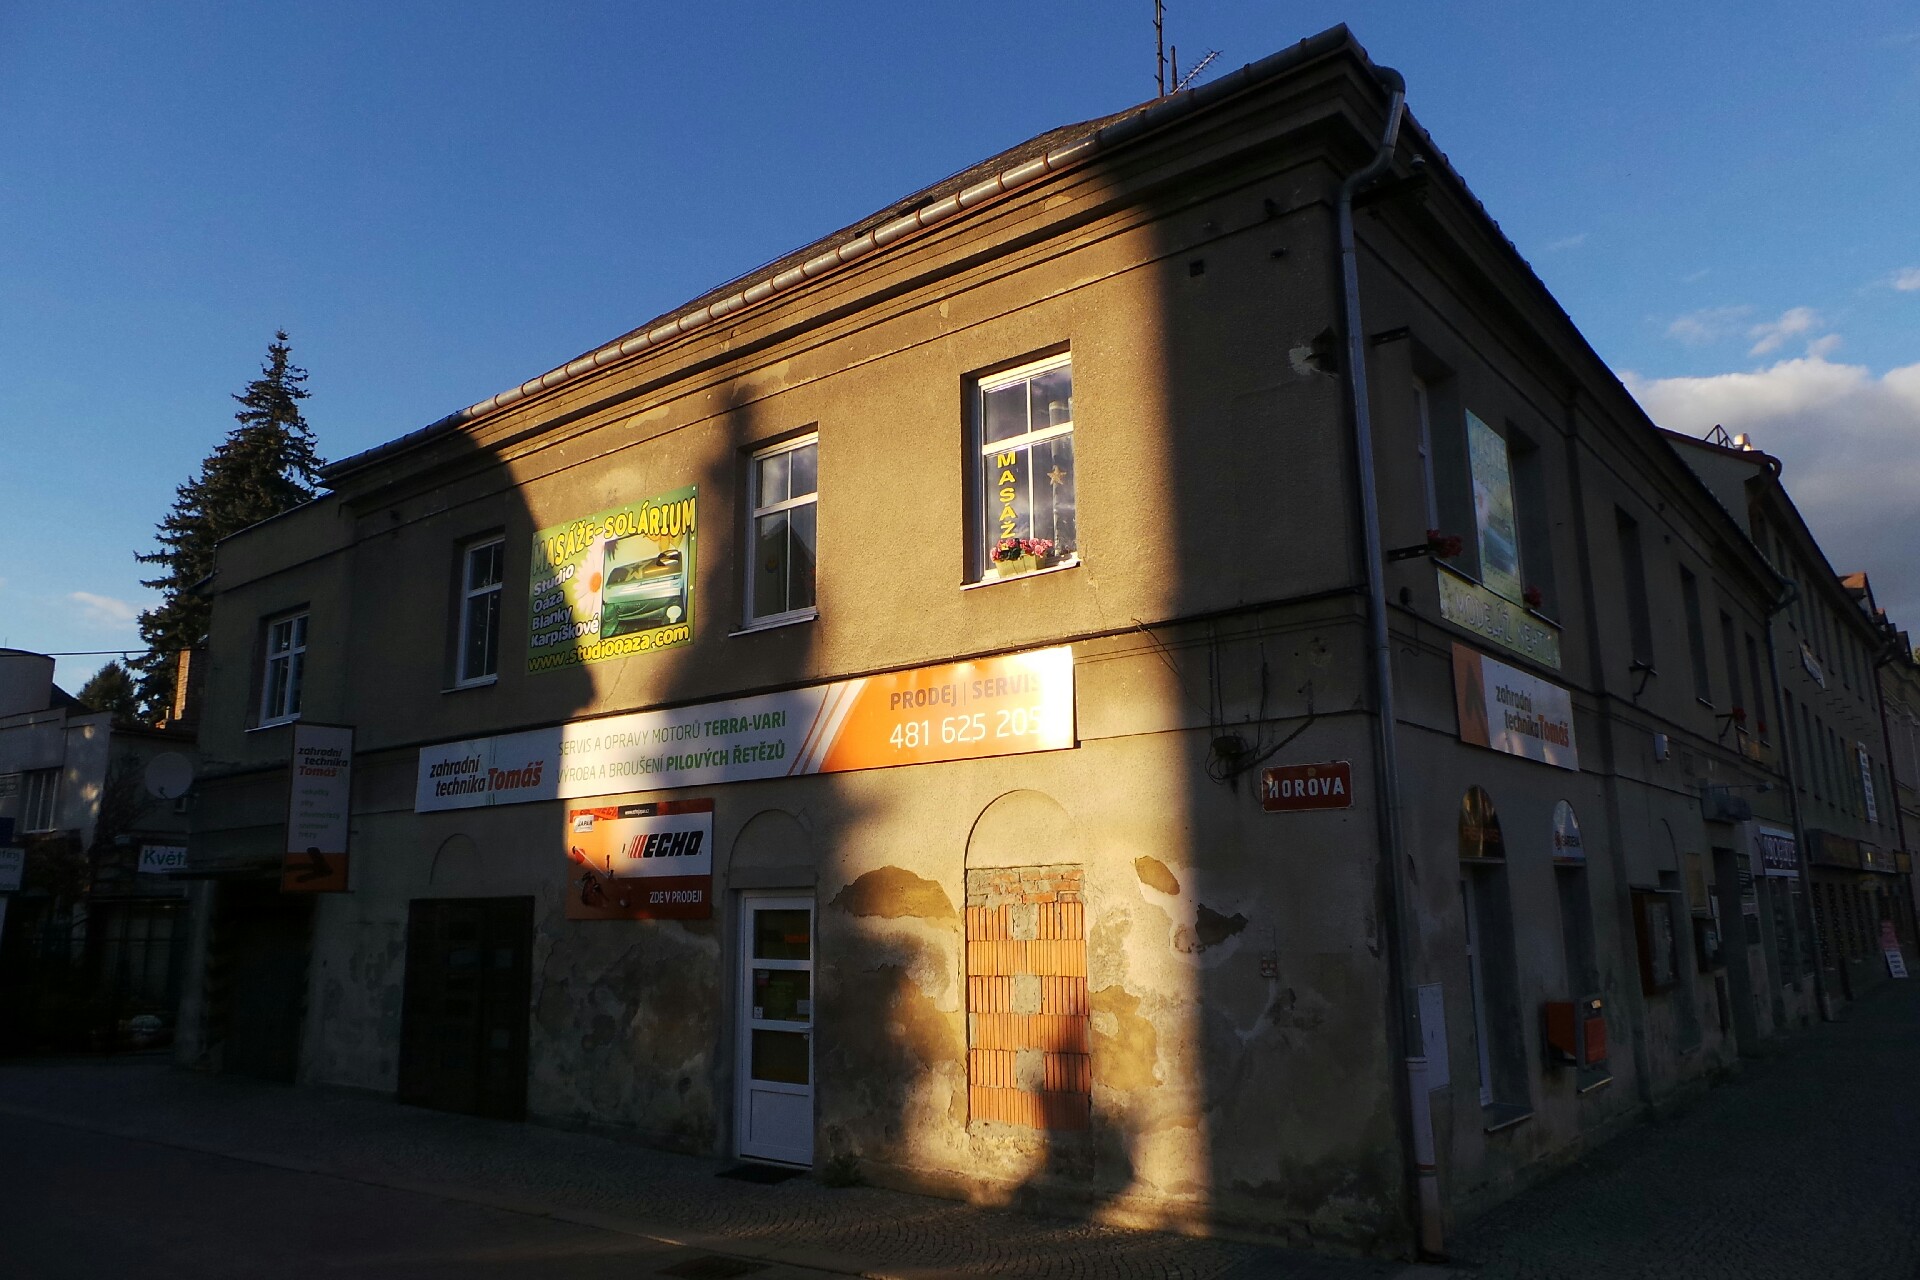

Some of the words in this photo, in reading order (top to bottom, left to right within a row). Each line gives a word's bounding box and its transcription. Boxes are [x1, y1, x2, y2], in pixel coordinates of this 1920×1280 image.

[533, 563, 576, 596] Studio
[532, 590, 565, 613] Oáza
[531, 605, 574, 631] Blanky
[890, 684, 957, 711] PRODEJ
[972, 673, 1040, 700] SERVIS
[558, 735, 592, 757] SERVIS
[593, 735, 602, 752] A
[604, 729, 649, 751] OPRAVY
[651, 719, 701, 744] MOTORŮ
[704, 710, 786, 737] TERRA-VARI
[889, 720, 930, 749] 481
[941, 713, 986, 743] 625
[996, 705, 1043, 738] 205
[299, 766, 338, 777] Tomáš
[304, 757, 348, 768] technika
[429, 754, 481, 779] zahradní
[557, 758, 597, 783] VÝROBA
[598, 760, 607, 779] A
[609, 753, 664, 777] BROUŠENÍ
[665, 746, 729, 772] PILOVÝCH
[732, 738, 785, 765] ŘETĚZŮ
[435, 771, 486, 798] technika
[487, 760, 544, 792] Tomáš
[642, 830, 704, 858] ECHO
[650, 890, 664, 904] ZDE
[665, 890, 671, 903] V
[672, 890, 703, 903] PRODEJI
